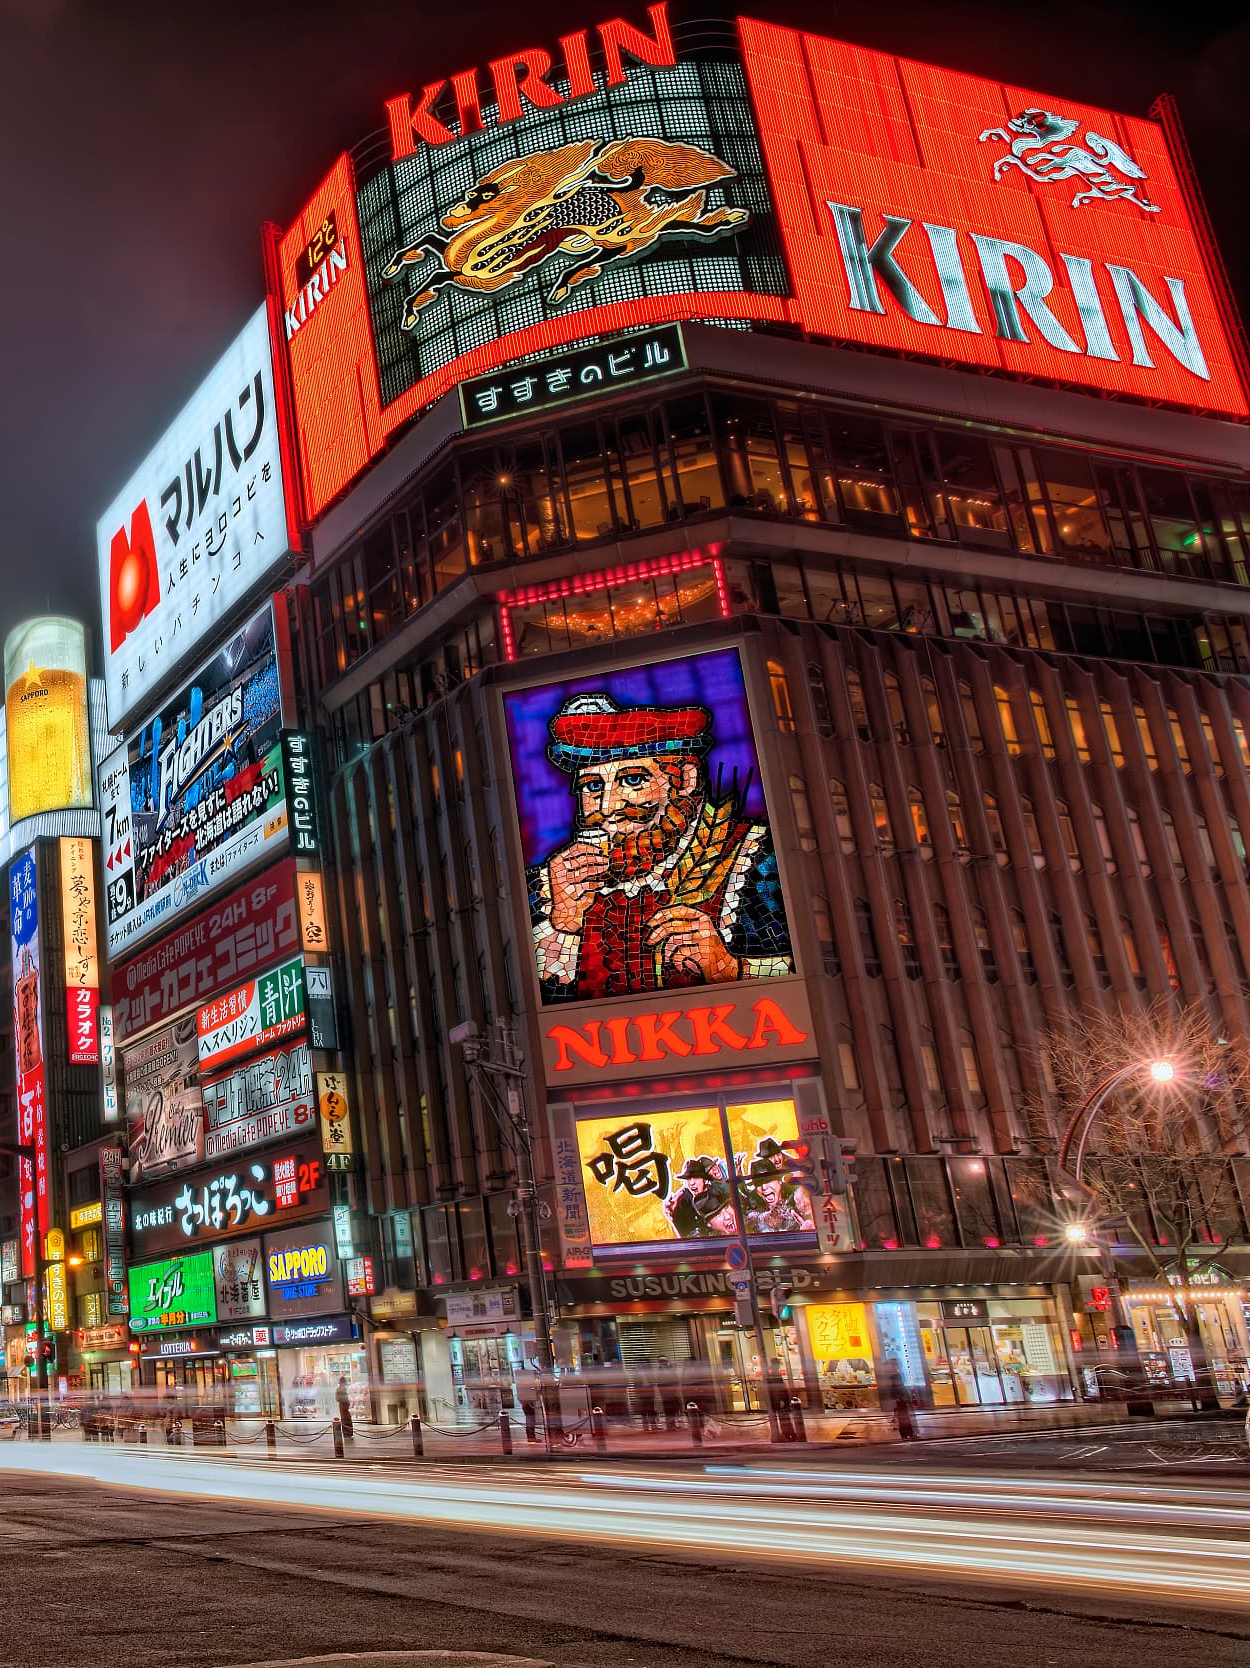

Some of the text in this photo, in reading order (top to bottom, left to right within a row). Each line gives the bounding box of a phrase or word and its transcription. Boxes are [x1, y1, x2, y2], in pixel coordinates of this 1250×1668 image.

[385, 2, 677, 162] KIRIN
[284, 239, 347, 341] KIRIN
[825, 200, 1211, 381] KIRIN
[475, 340, 670, 413] すすきのビル
[160, 369, 265, 548] マルハン
[166, 460, 272, 595] 人生にヨロコビを
[120, 531, 266, 690] 新しいパチンコへ
[20, 688, 49, 703] SAPPORO
[101, 761, 128, 794] 札幌ドーム
[156, 684, 246, 832] FIGHTERS
[110, 783, 121, 800] まで
[287, 735, 315, 849] すすきのビル
[104, 804, 130, 847] 7km
[139, 786, 227, 869] ファイターズを見ずに
[226, 833, 260, 863] ファイターズ
[174, 921, 207, 961] POPEYE
[209, 897, 247, 938] 24H
[251, 884, 278, 911] 8F
[76, 988, 94, 1050] カラオケ
[200, 989, 248, 1031] 新生活習慣
[261, 968, 303, 1027] 青汁
[200, 1013, 259, 1054] ヘスペリジン
[255, 1013, 307, 1047] ドリーム ファクトリー
[546, 997, 809, 1072] NIKKA
[102, 1044, 117, 1109] グリーンビル
[138, 1090, 200, 1162] Premier
[255, 1110, 291, 1140] POPEYE
[293, 1102, 317, 1125] 8F
[803, 1119, 828, 1132] uhb
[102, 1150, 121, 1164] 24H
[299, 1161, 320, 1192] 2F
[326, 1153, 351, 1171] 4F
[586, 1121, 671, 1200] 喝
[175, 1164, 269, 1237] さっぽろっこ
[557, 1140, 582, 1220] 北海道新聞
[135, 1206, 173, 1231] 北の味紀行
[269, 1246, 327, 1283] SAPPORO
[755, 1268, 821, 1289] BLD.
[148, 1271, 184, 1309] エイブル
[298, 1284, 318, 1299] STORE
[160, 1341, 191, 1354] LOTTERIA
[254, 1329, 268, 1344] 薬
